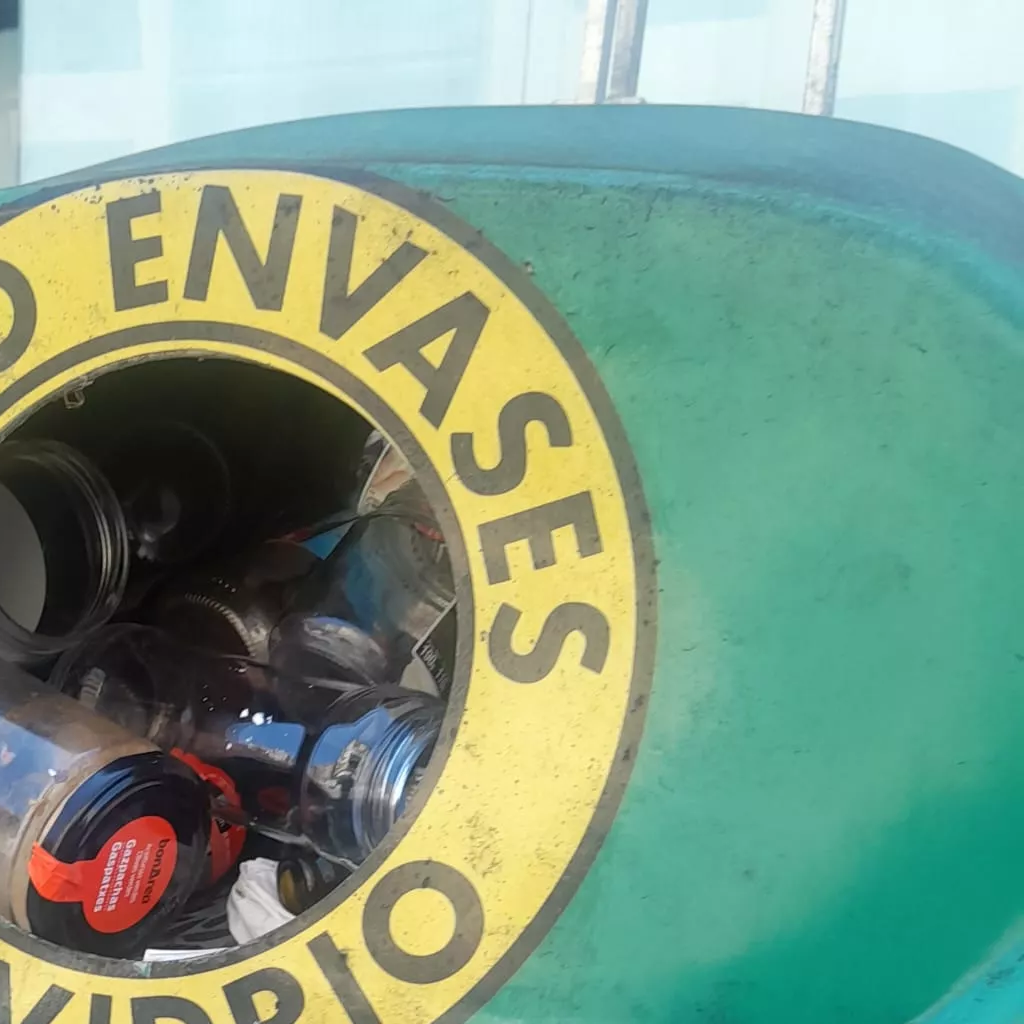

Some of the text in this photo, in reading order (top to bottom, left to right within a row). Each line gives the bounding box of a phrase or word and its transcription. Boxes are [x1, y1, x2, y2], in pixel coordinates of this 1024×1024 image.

[105, 184, 611, 685] ENVASES
[93, 842, 122, 912] Gaspatxes
[107, 839, 136, 911] Gazpachas
[142, 839, 170, 904] bonArea
